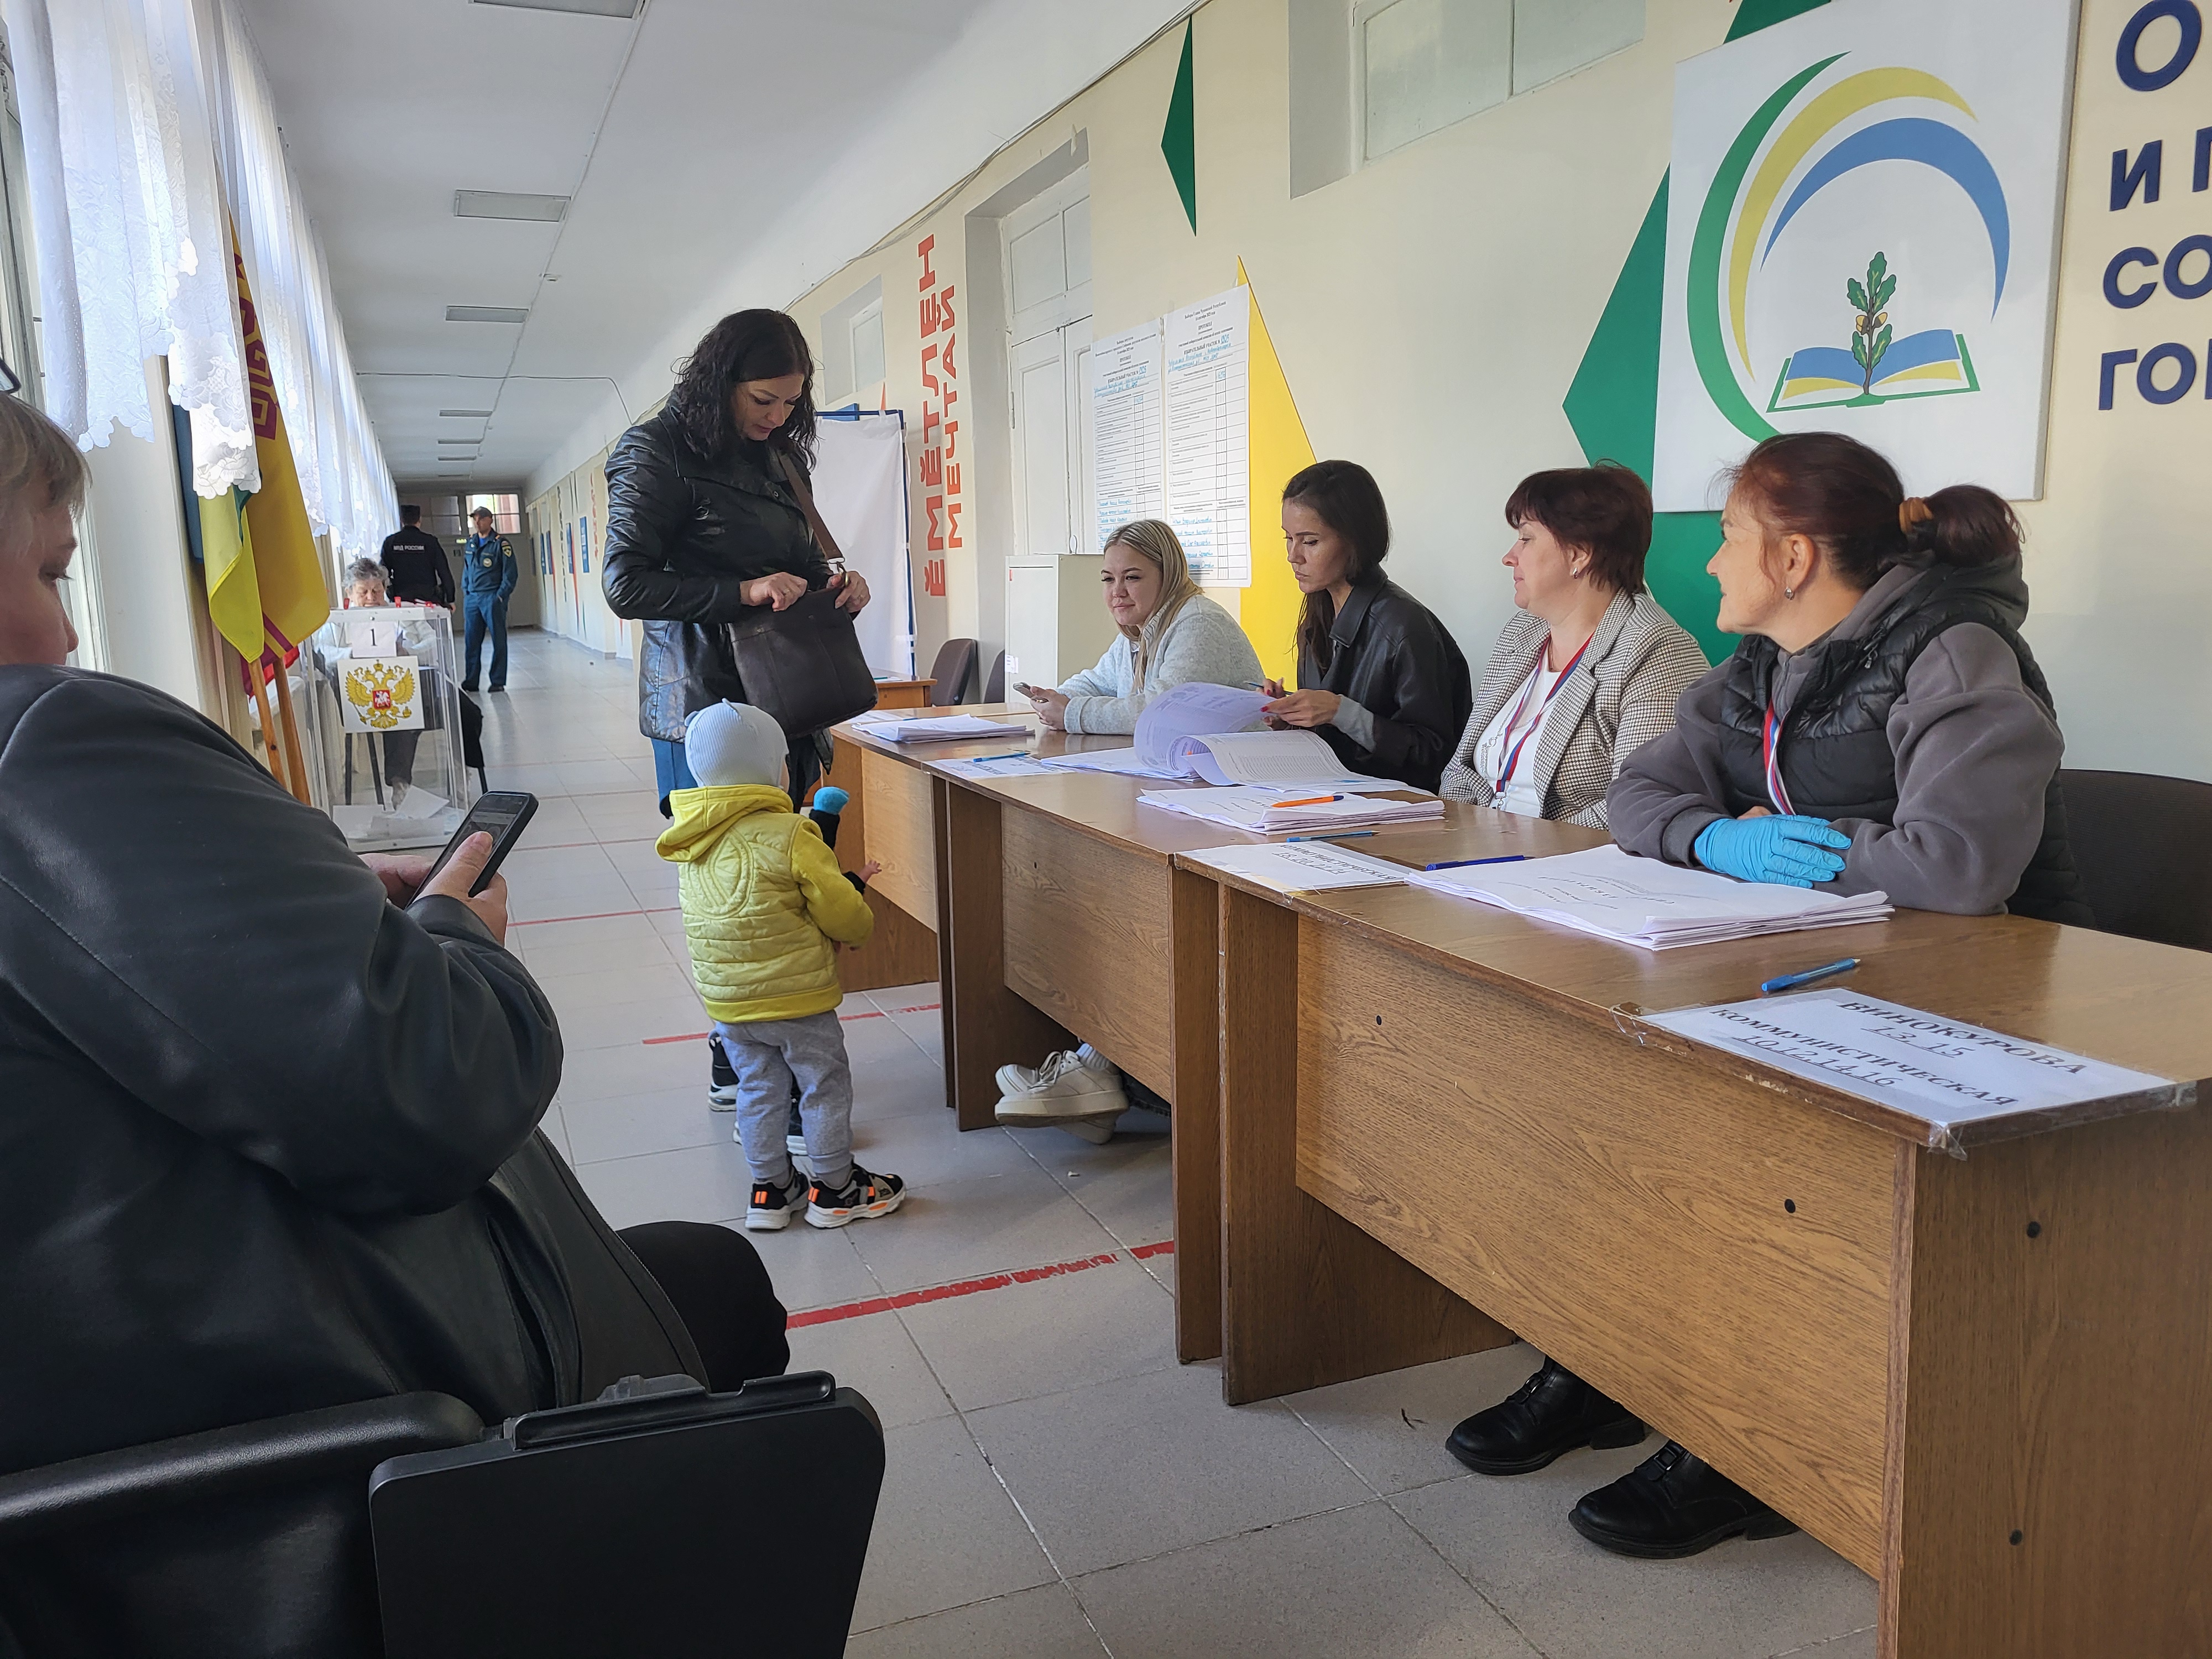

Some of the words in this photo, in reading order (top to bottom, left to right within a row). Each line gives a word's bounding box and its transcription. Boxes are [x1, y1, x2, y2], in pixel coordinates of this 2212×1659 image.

[2109, 139, 2163, 212] И
[2098, 338, 2212, 411] ГО
[935, 284, 963, 549] МЕЧТАЙ
[370, 628, 377, 647] 1
[1709, 1009, 2020, 1105] КОММУНИСТИЧЕСКАЯ
[1836, 1002, 2088, 1074] ВИНОКУРОВА
